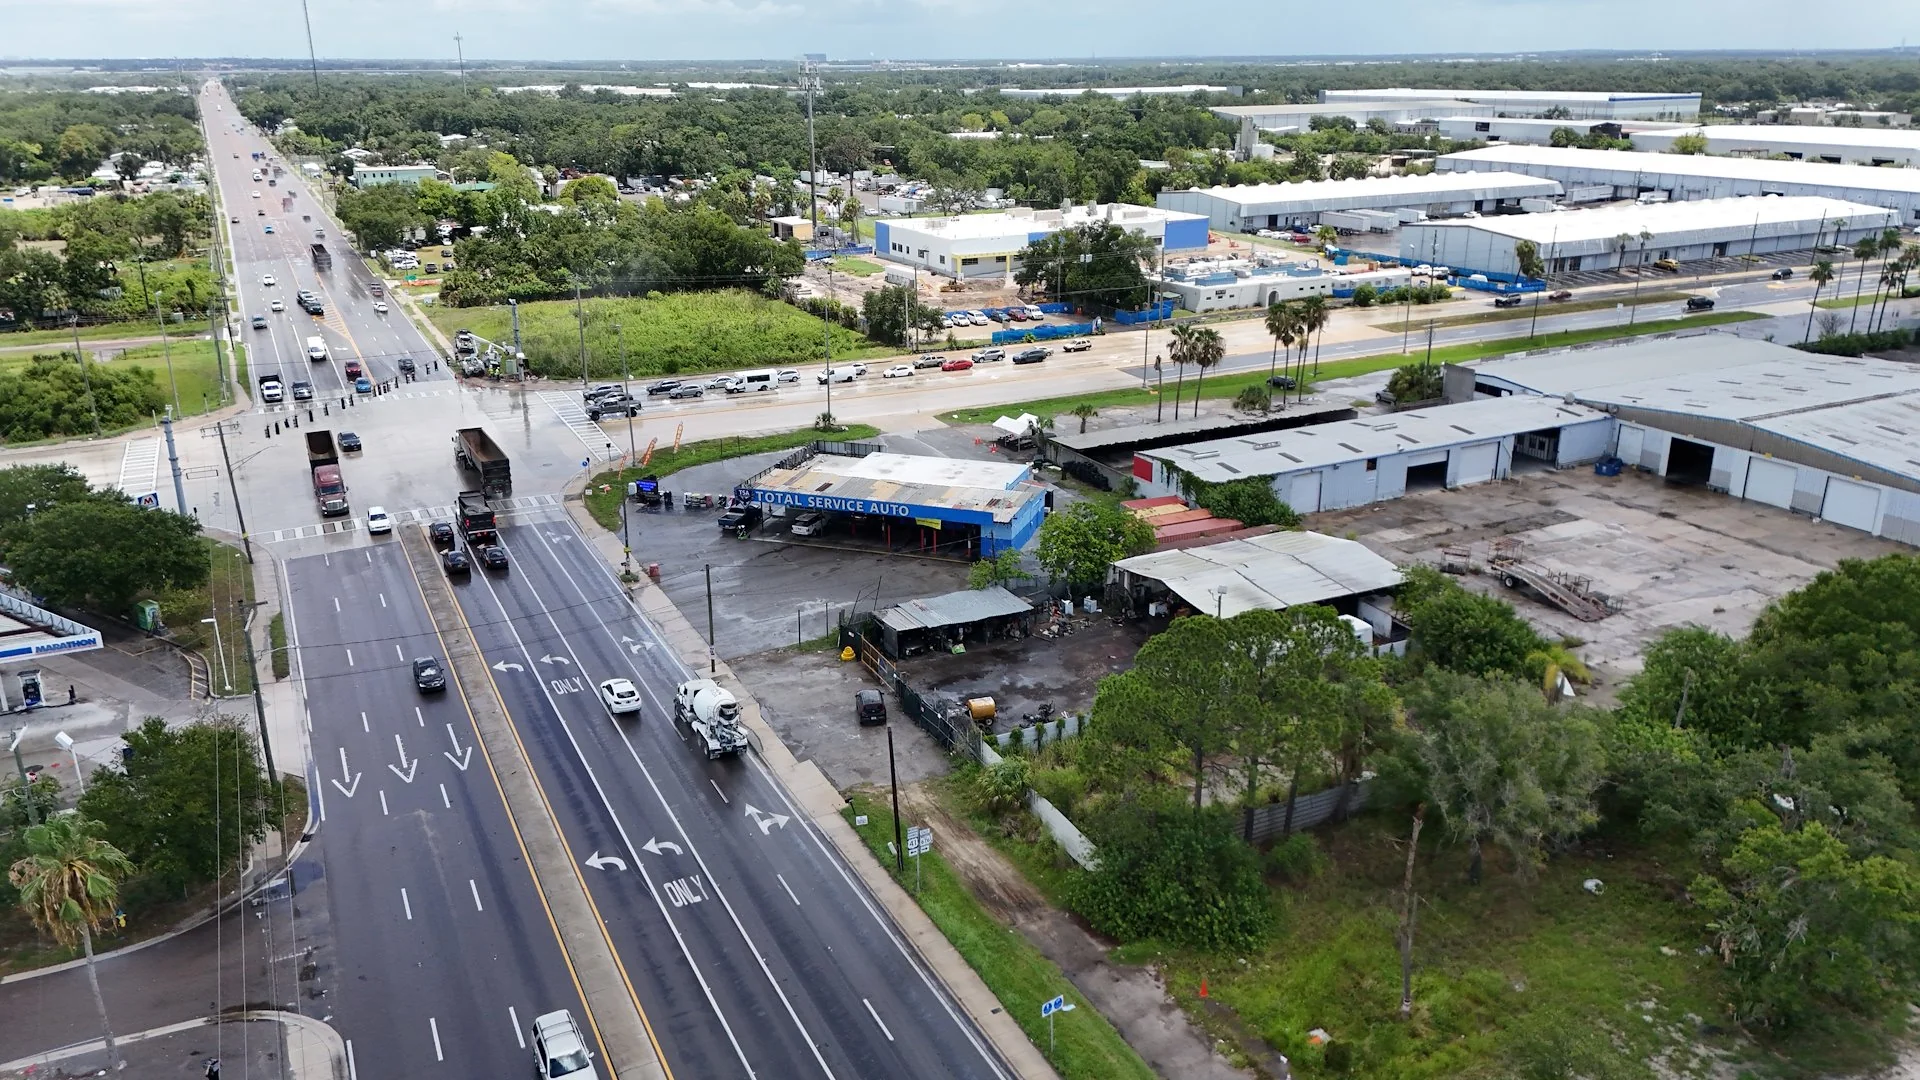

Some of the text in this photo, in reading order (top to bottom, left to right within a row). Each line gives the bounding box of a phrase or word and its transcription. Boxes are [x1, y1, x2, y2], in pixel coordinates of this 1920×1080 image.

[756, 491, 909, 517] TOTAL SERVICE AUTO
[36, 638, 97, 653] MARATHON
[551, 677, 584, 695] ONLY
[663, 874, 709, 907] ONLY
